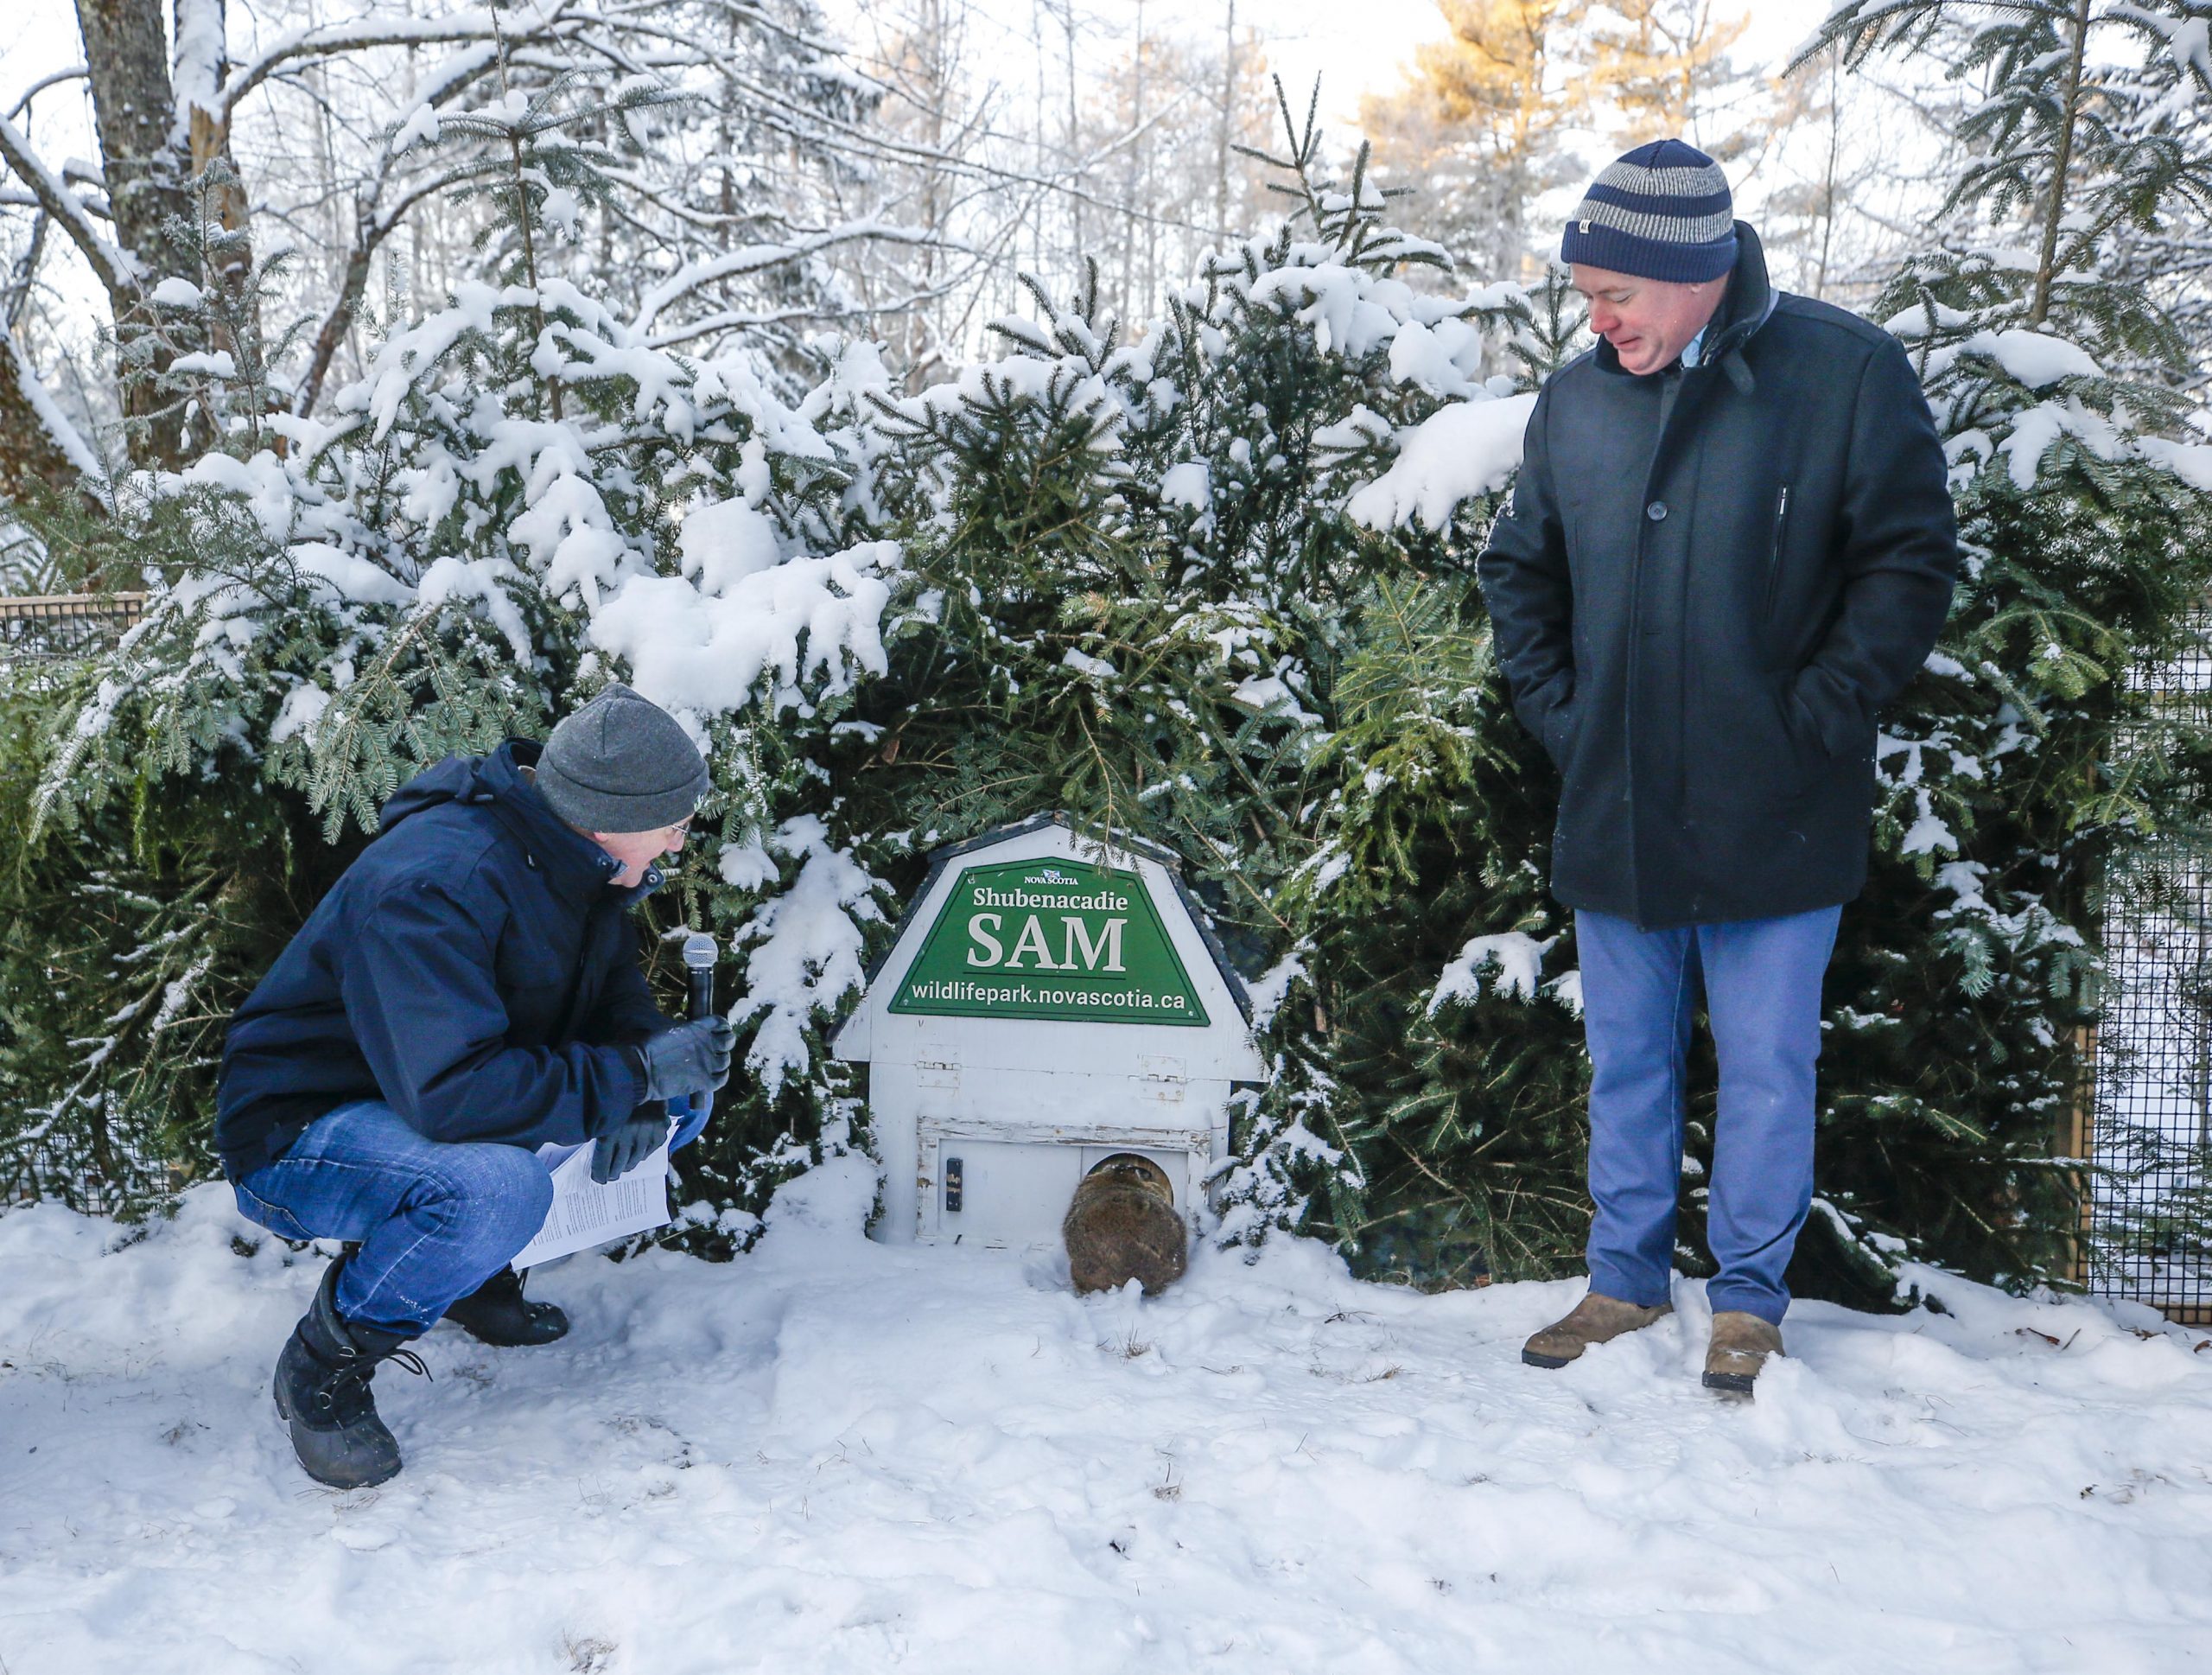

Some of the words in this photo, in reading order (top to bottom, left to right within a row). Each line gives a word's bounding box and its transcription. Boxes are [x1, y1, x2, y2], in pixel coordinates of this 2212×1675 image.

[1024, 876, 1046, 884] NOVA
[1047, 876, 1079, 885] SCOTIA
[973, 887, 1128, 911] Shubenacadie
[966, 913, 1128, 972] SAM
[912, 980, 1185, 1009] wildlifepark.novascotia.ca
